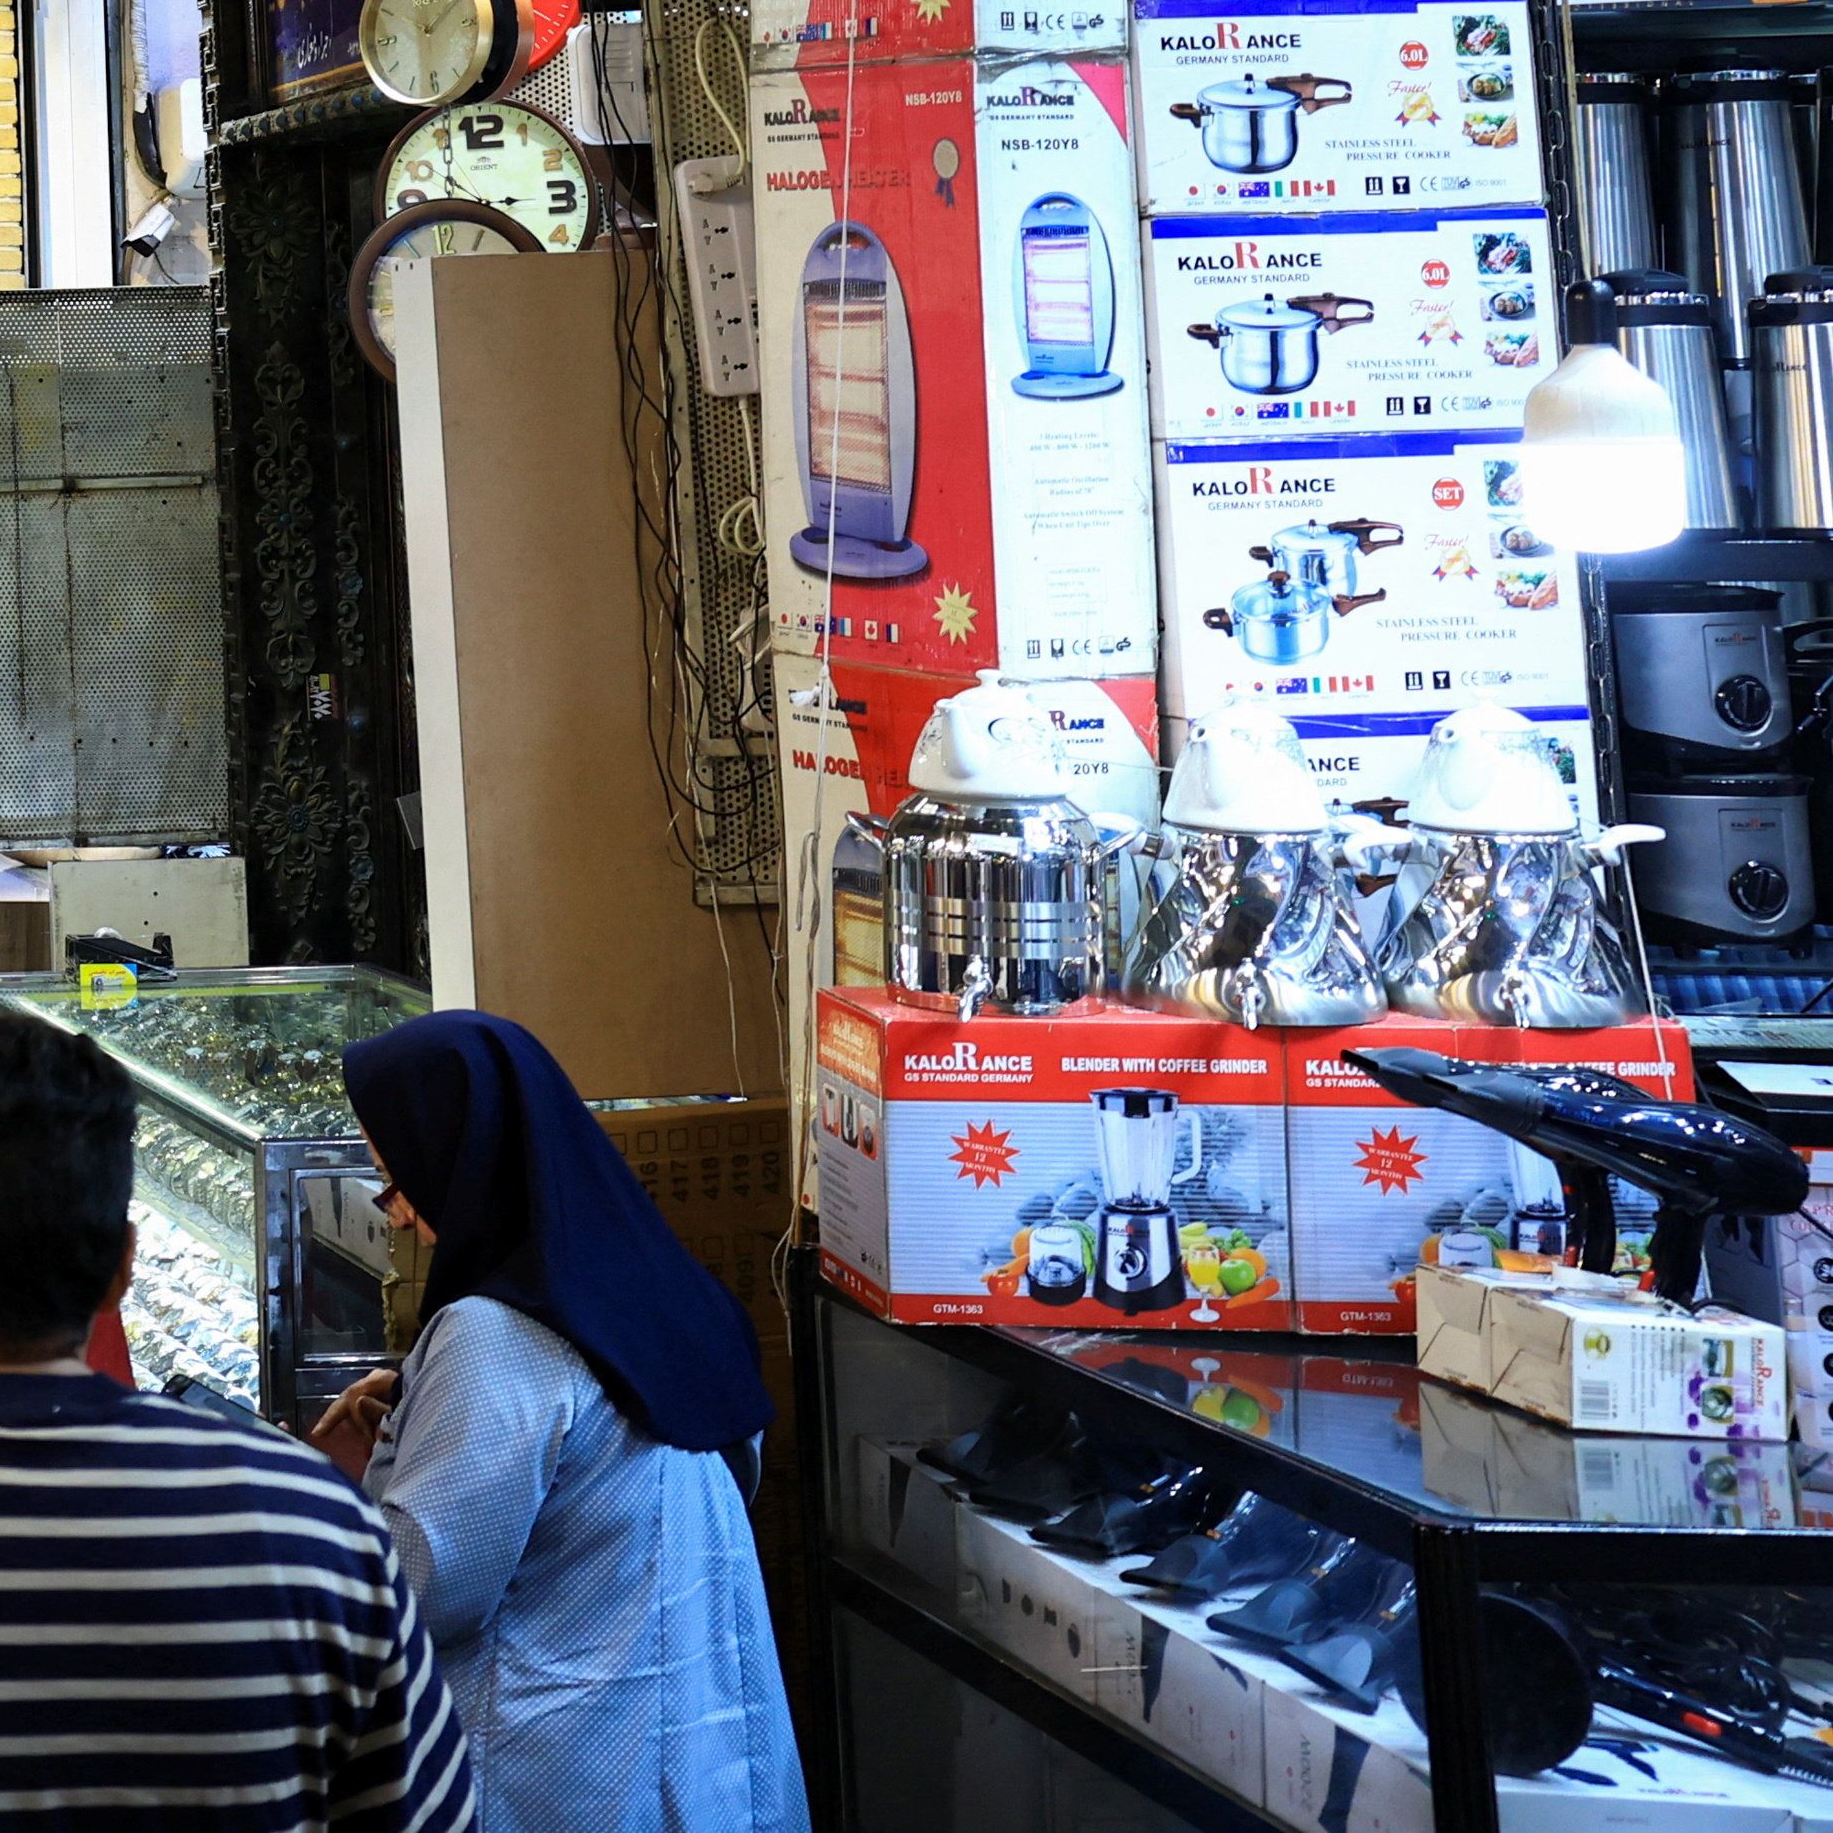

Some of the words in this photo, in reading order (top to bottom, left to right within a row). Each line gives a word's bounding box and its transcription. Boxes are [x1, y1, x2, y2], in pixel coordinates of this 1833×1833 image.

[1175, 56, 1228, 65] GERMANY
[1232, 54, 1289, 64] STANDARD
[905, 91, 963, 106] NSB-120Y8
[1001, 139, 1079, 151] NSB-120Y8
[1325, 140, 1381, 149] STAINLESS
[1383, 139, 1417, 148] STEEL
[1346, 152, 1399, 161] PRESSURE
[1405, 150, 1451, 160] COOKER
[458, 115, 504, 150] 12
[547, 180, 577, 215] 3
[470, 163, 498, 171] ORIENT
[1194, 275, 1247, 285] GERMANY
[1252, 273, 1310, 284] STANDARD
[1208, 501, 1261, 511] GERMANY
[1265, 499, 1323, 509] STANDARD
[1061, 1057, 1119, 1073] BLENDER
[1122, 1058, 1155, 1072] WITH
[1158, 1058, 1208, 1073] COFFEE
[1210, 1059, 1267, 1074] GRINDER
[1617, 1061, 1675, 1077] GRINDER
[904, 1073, 920, 1083] GS
[923, 1073, 978, 1083] STANDARD
[980, 1073, 1033, 1084] GERMANY
[933, 1304, 983, 1315] GTM-1363
[1339, 1311, 1392, 1323] GTM-1363
